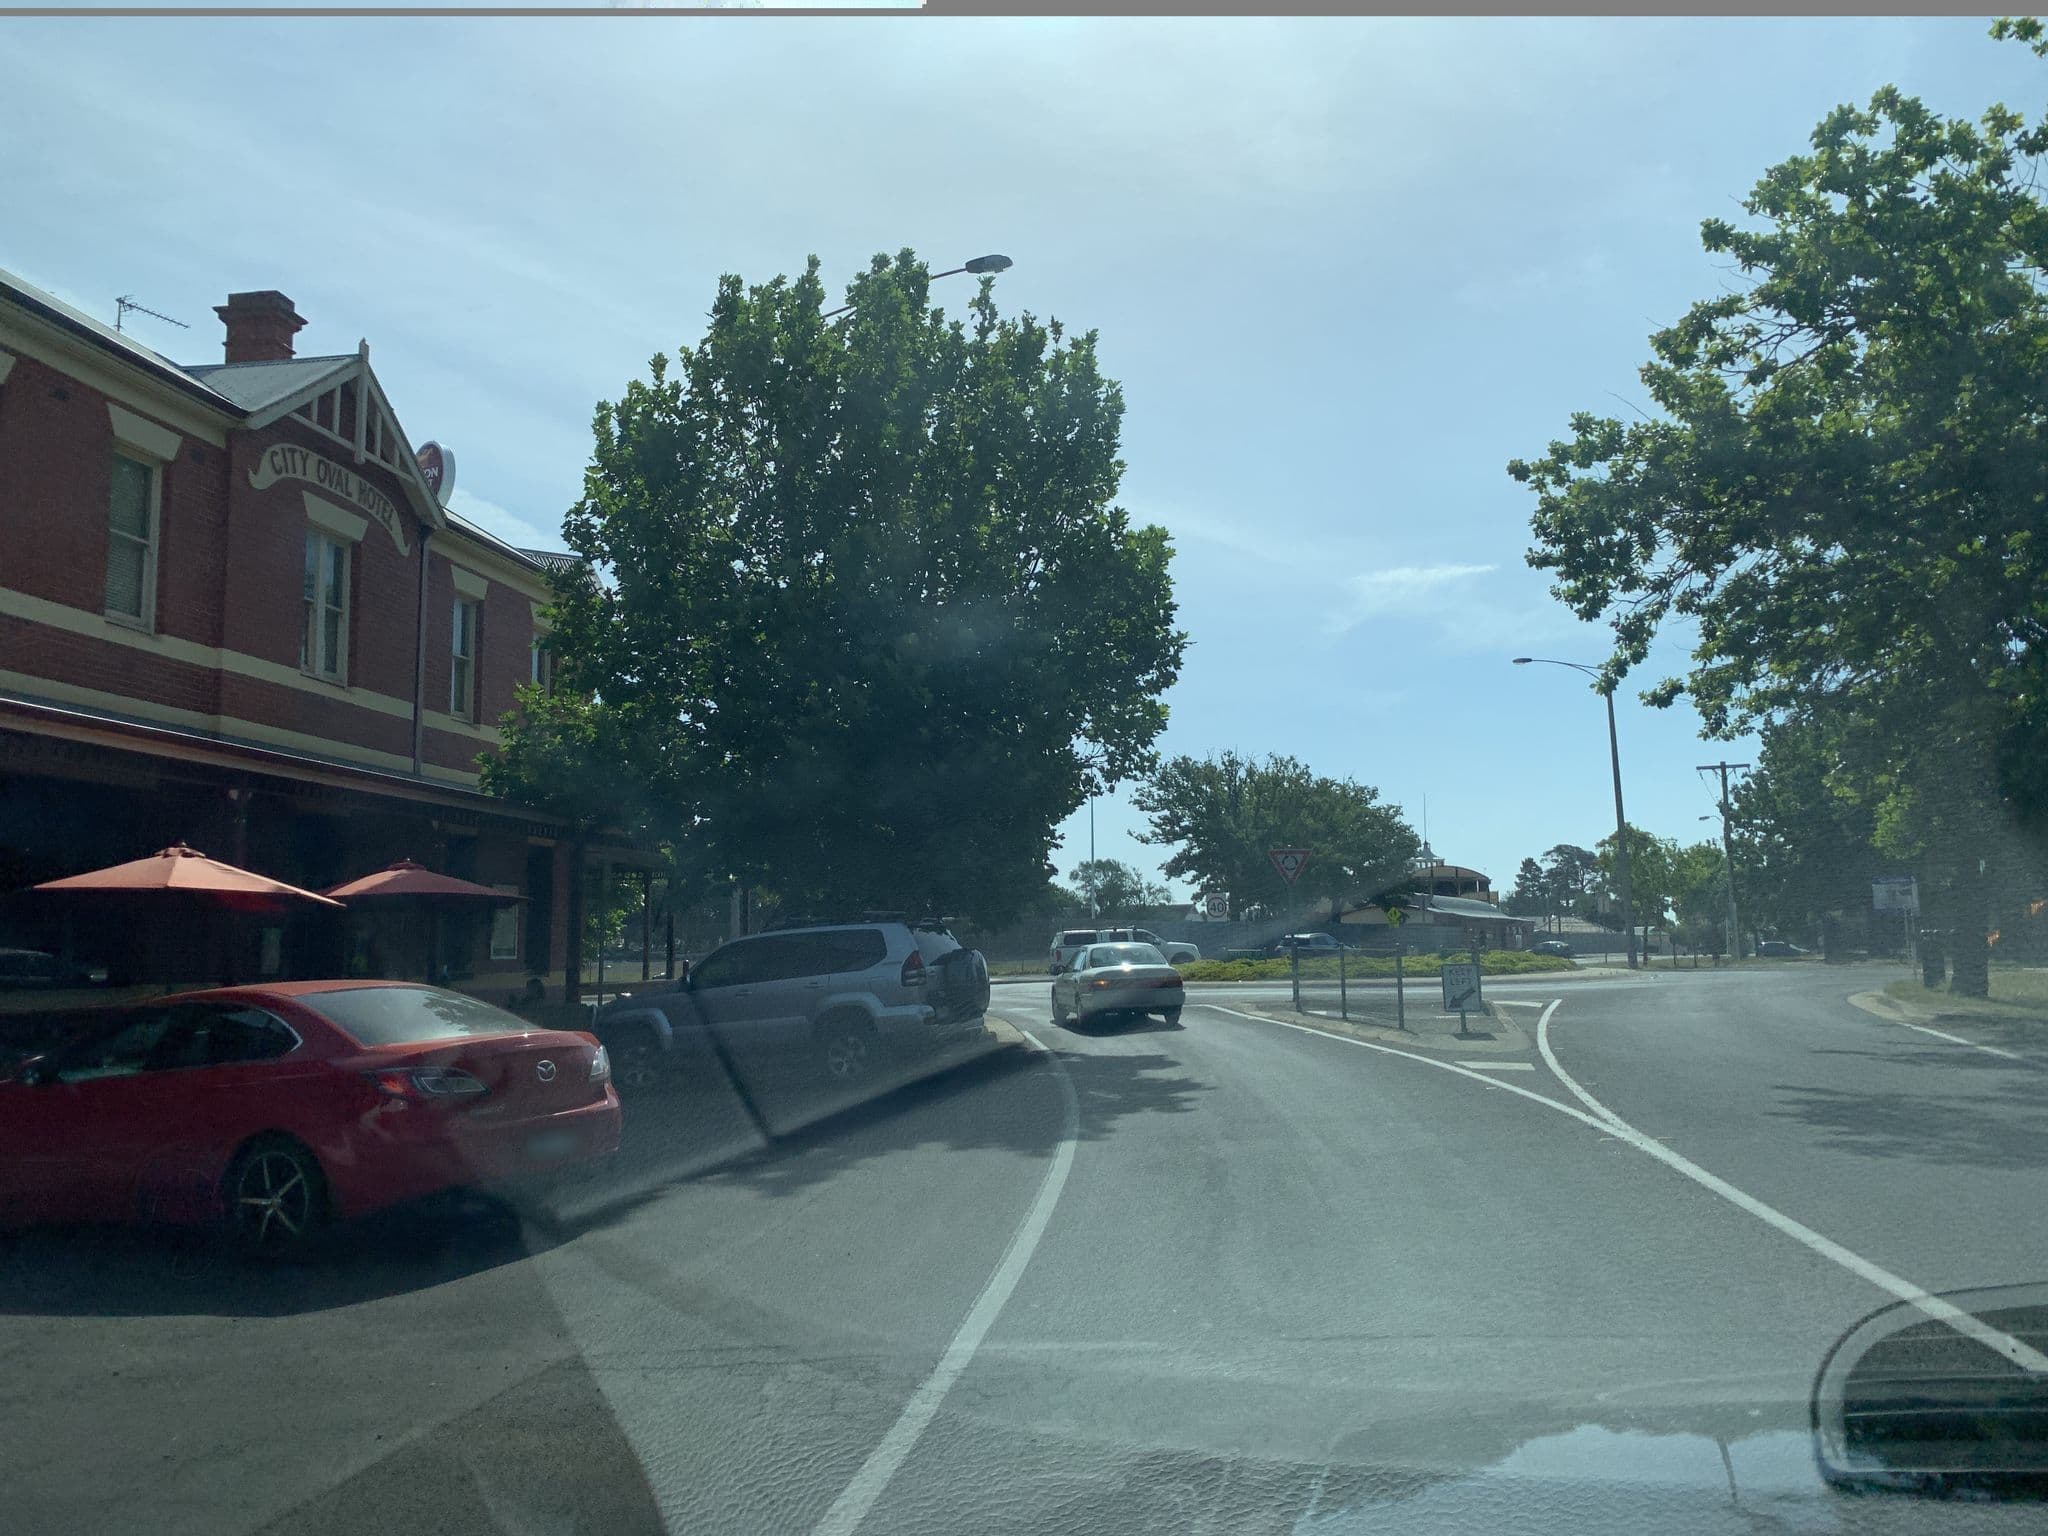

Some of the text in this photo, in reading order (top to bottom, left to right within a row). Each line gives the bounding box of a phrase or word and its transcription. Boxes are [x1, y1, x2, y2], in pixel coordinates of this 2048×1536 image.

[270, 447, 393, 532] CITY OVAL HOTEL
[1210, 902, 1225, 913] 40
[1449, 967, 1472, 977] KEEP
[1450, 976, 1473, 986] LEFT
